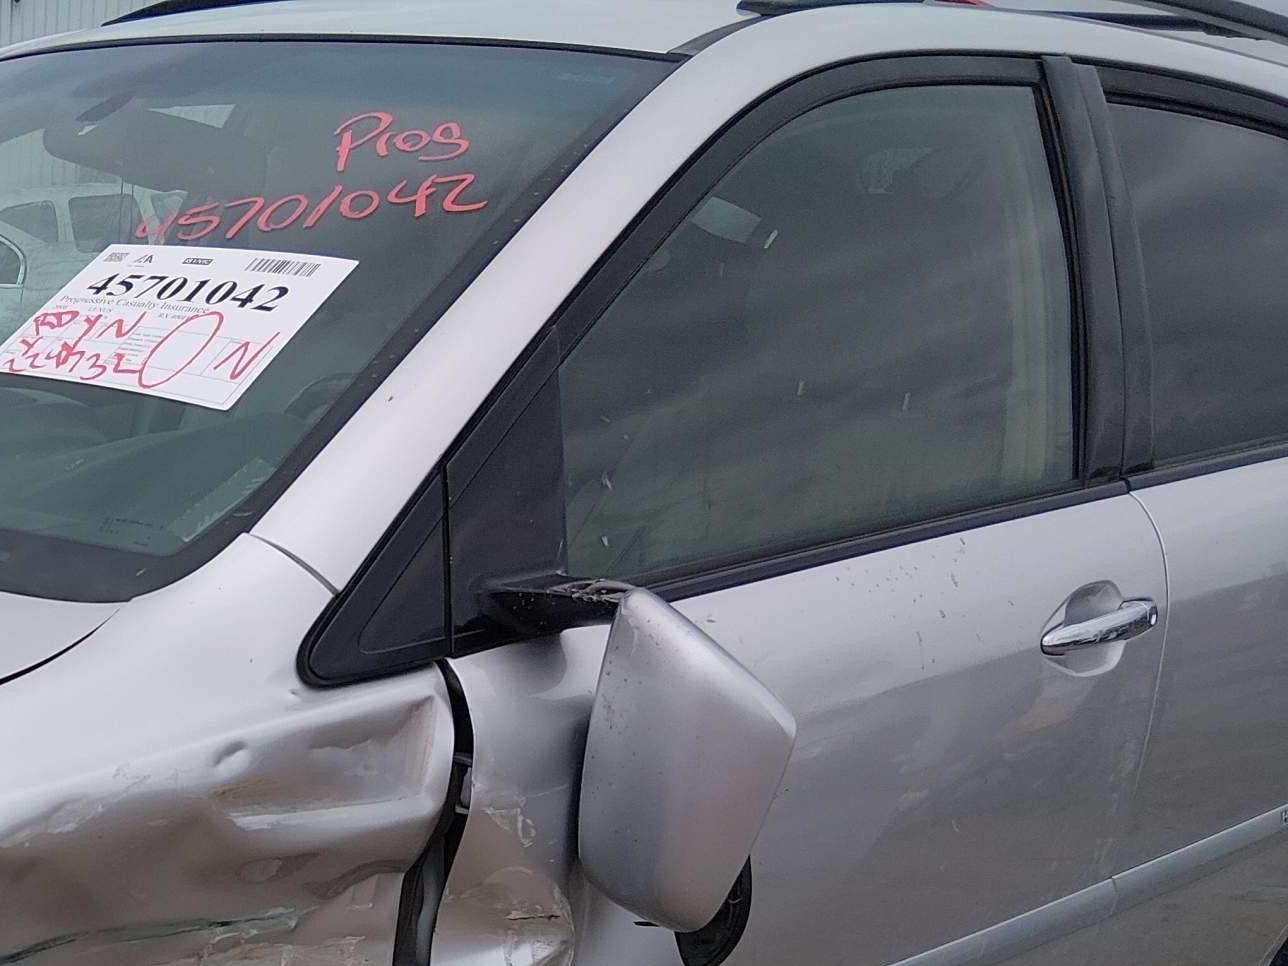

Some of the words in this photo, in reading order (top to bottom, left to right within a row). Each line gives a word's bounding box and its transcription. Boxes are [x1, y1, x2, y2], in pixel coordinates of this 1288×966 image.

[86, 272, 290, 313] 45701042
[115, 297, 157, 310] Casualty
[160, 300, 210, 314] Insurance
